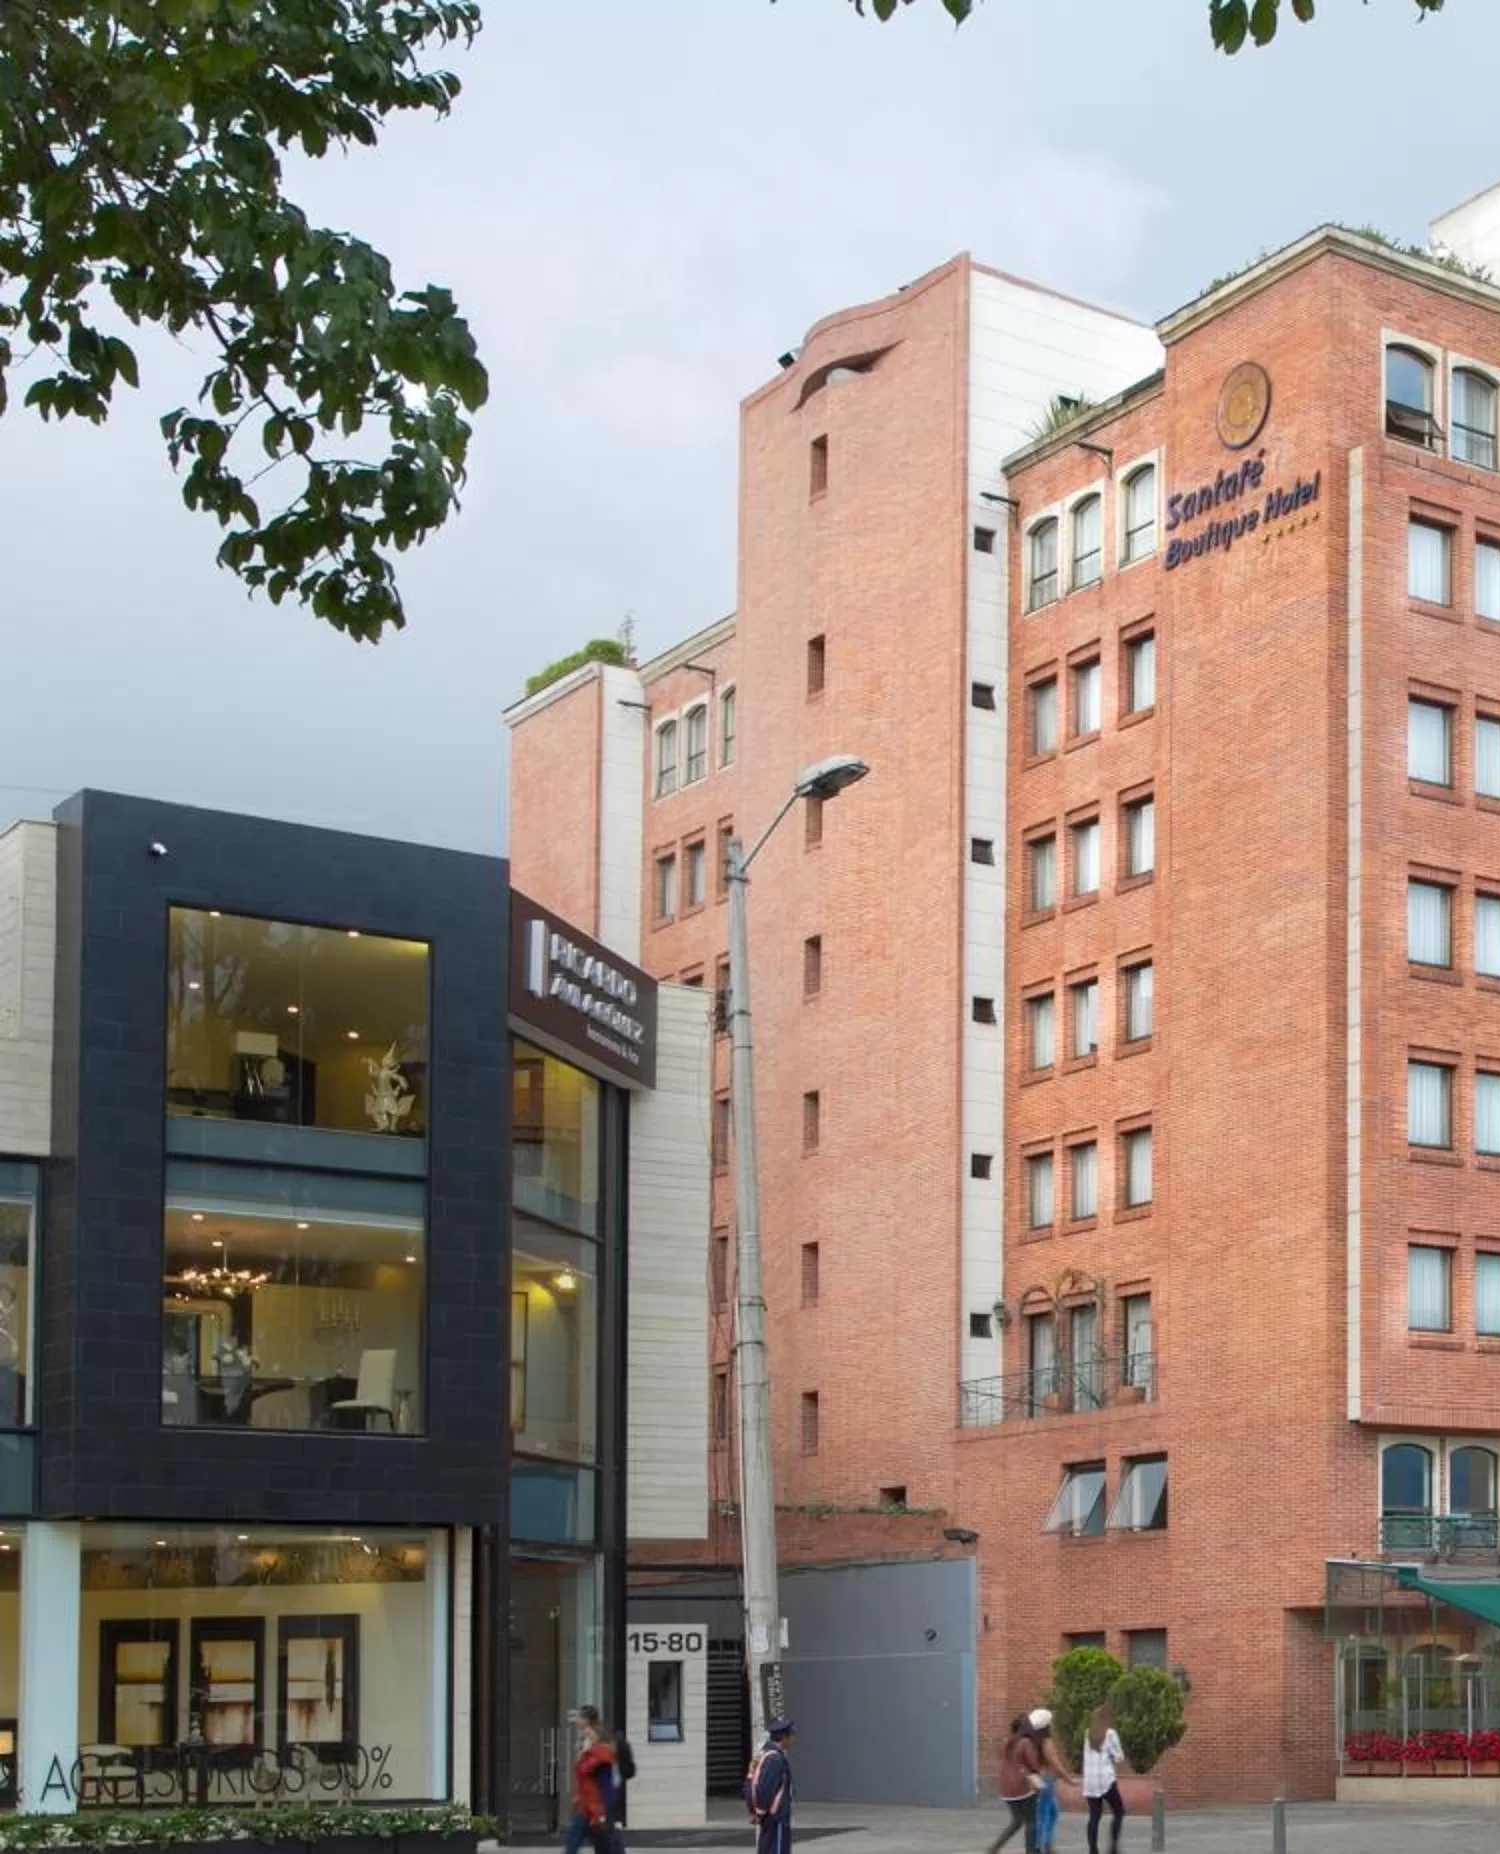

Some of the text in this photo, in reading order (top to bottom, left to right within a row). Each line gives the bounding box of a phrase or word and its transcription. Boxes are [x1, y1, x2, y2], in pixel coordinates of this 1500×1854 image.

[1164, 469, 1321, 571] Boutique Hotel
[1166, 448, 1266, 531] Santafé
[629, 1632, 702, 1653] 15-80
